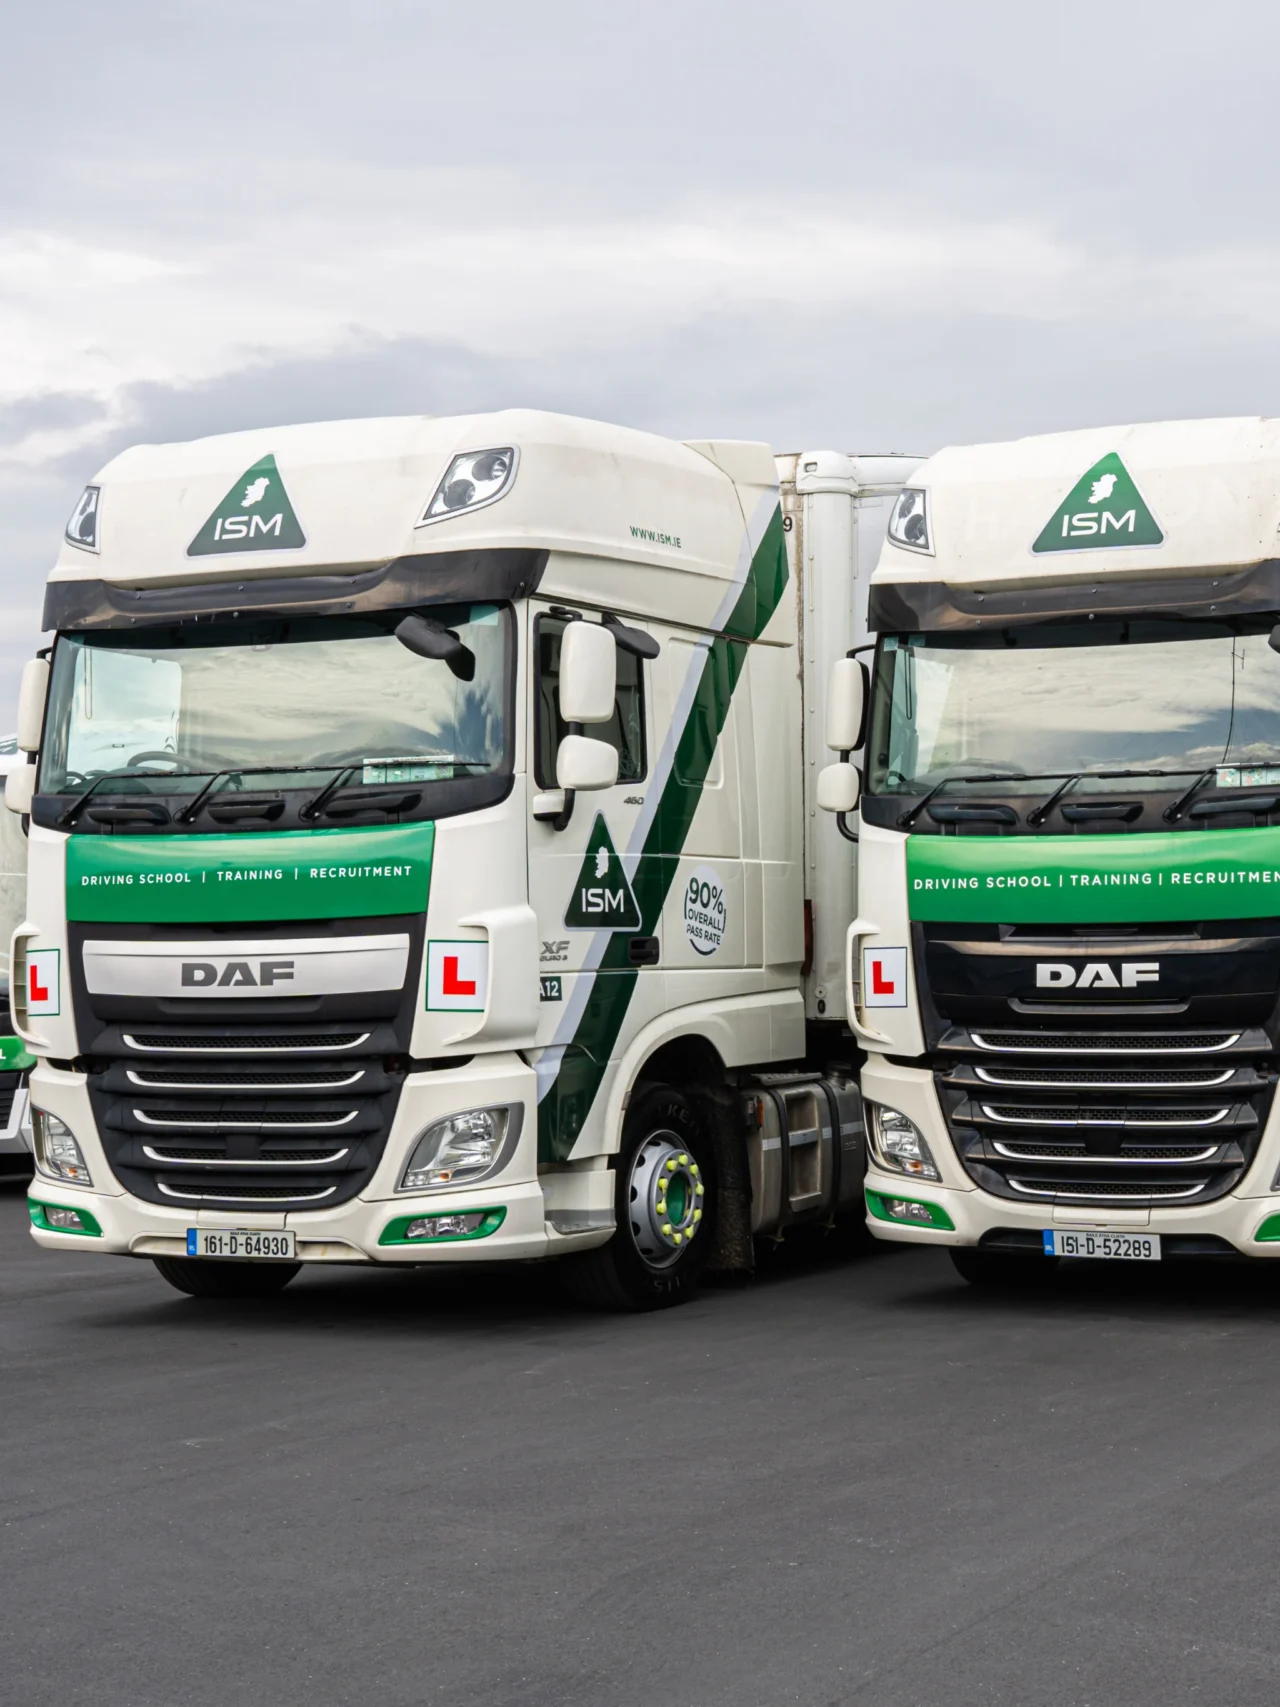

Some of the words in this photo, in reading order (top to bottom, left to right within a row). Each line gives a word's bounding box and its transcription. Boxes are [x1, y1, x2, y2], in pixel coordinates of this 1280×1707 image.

[214, 513, 284, 541] ISM
[629, 525, 682, 548] WWW.ISM.IE
[1061, 510, 1137, 538] ISM
[81, 874, 133, 886] DRIVING
[139, 872, 191, 884] SCHOOL
[217, 869, 283, 881] TRAINING
[310, 865, 412, 879] RECRUITMENT
[914, 878, 979, 890] DRIVING
[986, 876, 1051, 888] SCHOOL
[1070, 874, 1152, 886] TRAINING
[582, 888, 624, 913] ISM
[689, 877, 724, 915] 90%
[688, 908, 722, 932] OVERALL
[686, 923, 703, 940] PASS
[704, 929, 721, 946] RATE
[541, 940, 570, 955] XF
[30, 965, 48, 1001] L
[181, 961, 294, 987] DAF
[443, 956, 476, 995] L
[872, 961, 895, 994] L
[1036, 963, 1160, 988] DAF
[204, 1235, 289, 1256] 161-D-64930
[1061, 1235, 1152, 1258] 151-D-52289
